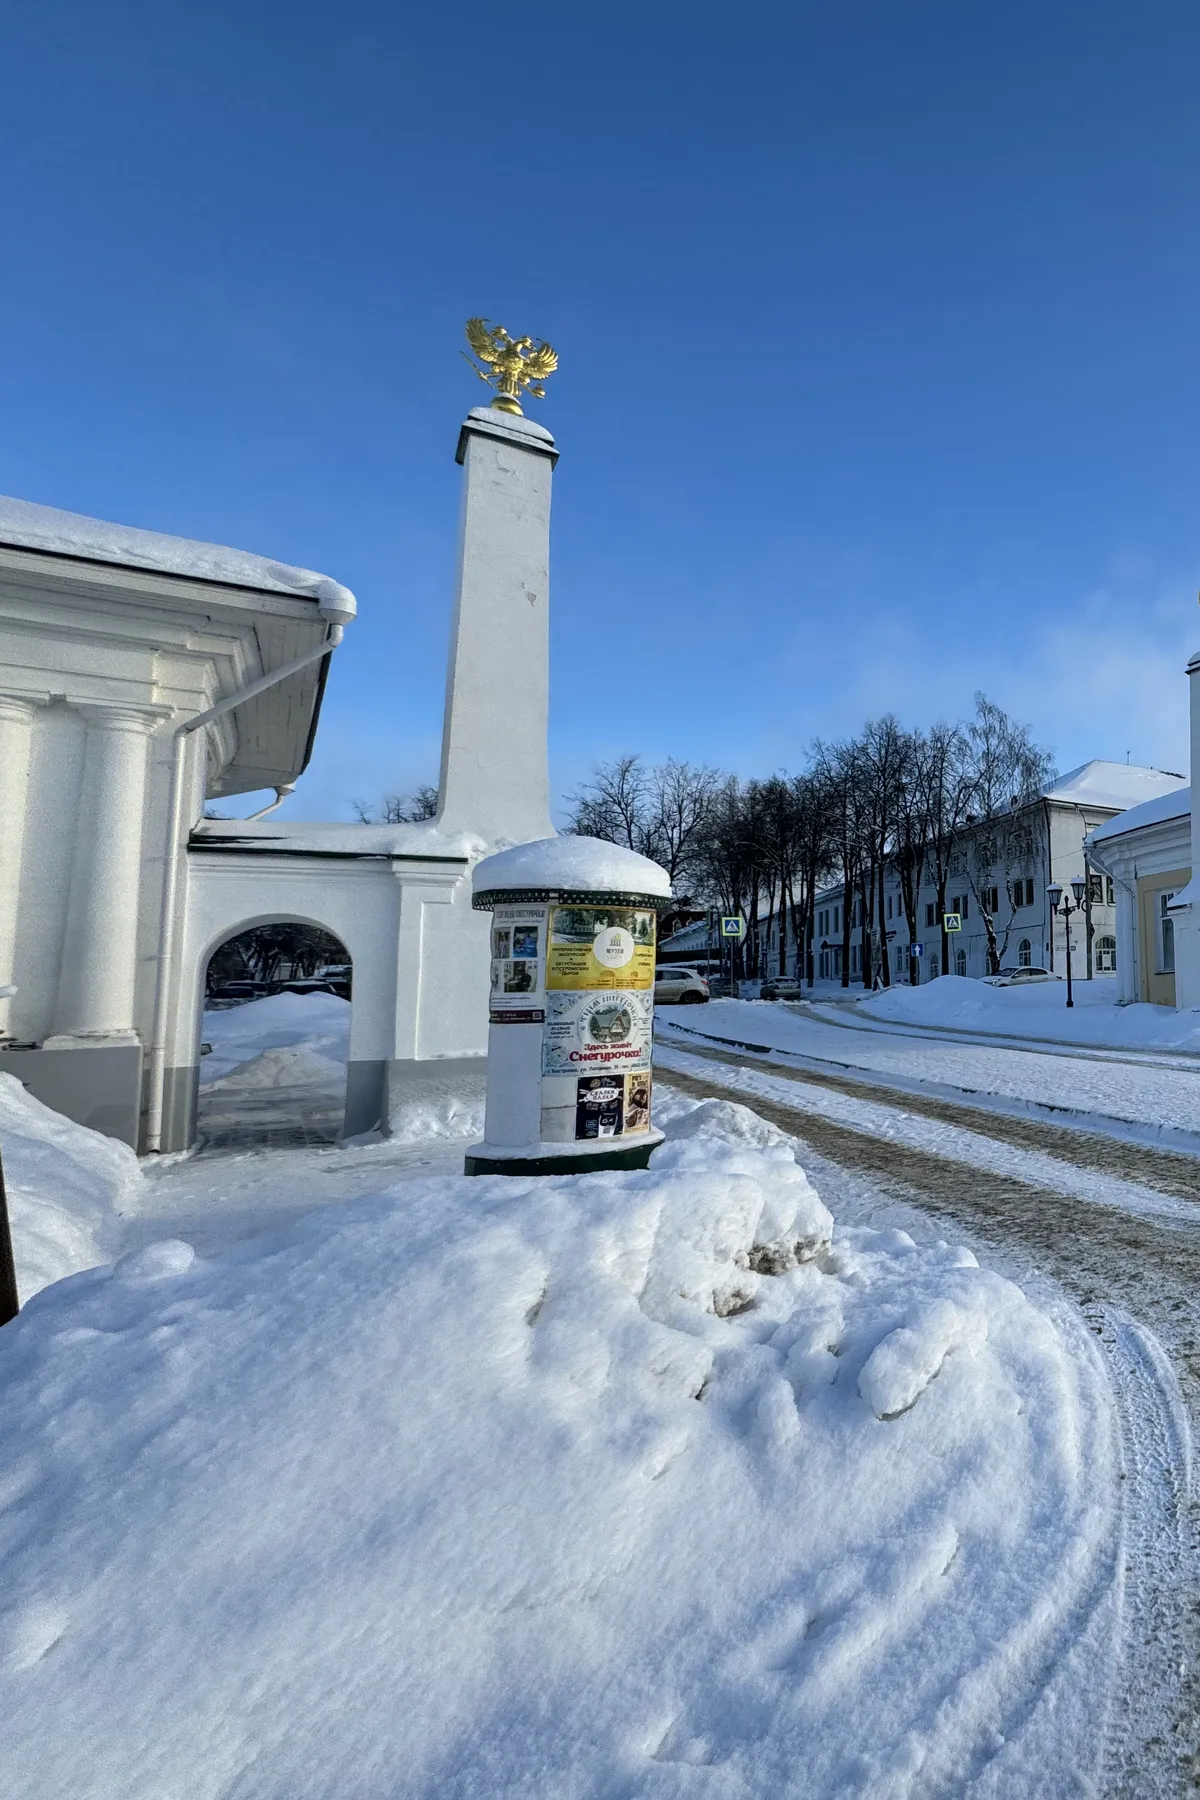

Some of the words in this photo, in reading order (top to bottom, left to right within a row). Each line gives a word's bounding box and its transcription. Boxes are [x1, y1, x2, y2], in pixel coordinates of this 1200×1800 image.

[584, 1043, 609, 1052] Здесь
[610, 1041, 633, 1050] живёт
[569, 1047, 642, 1063] Снегурочка!
